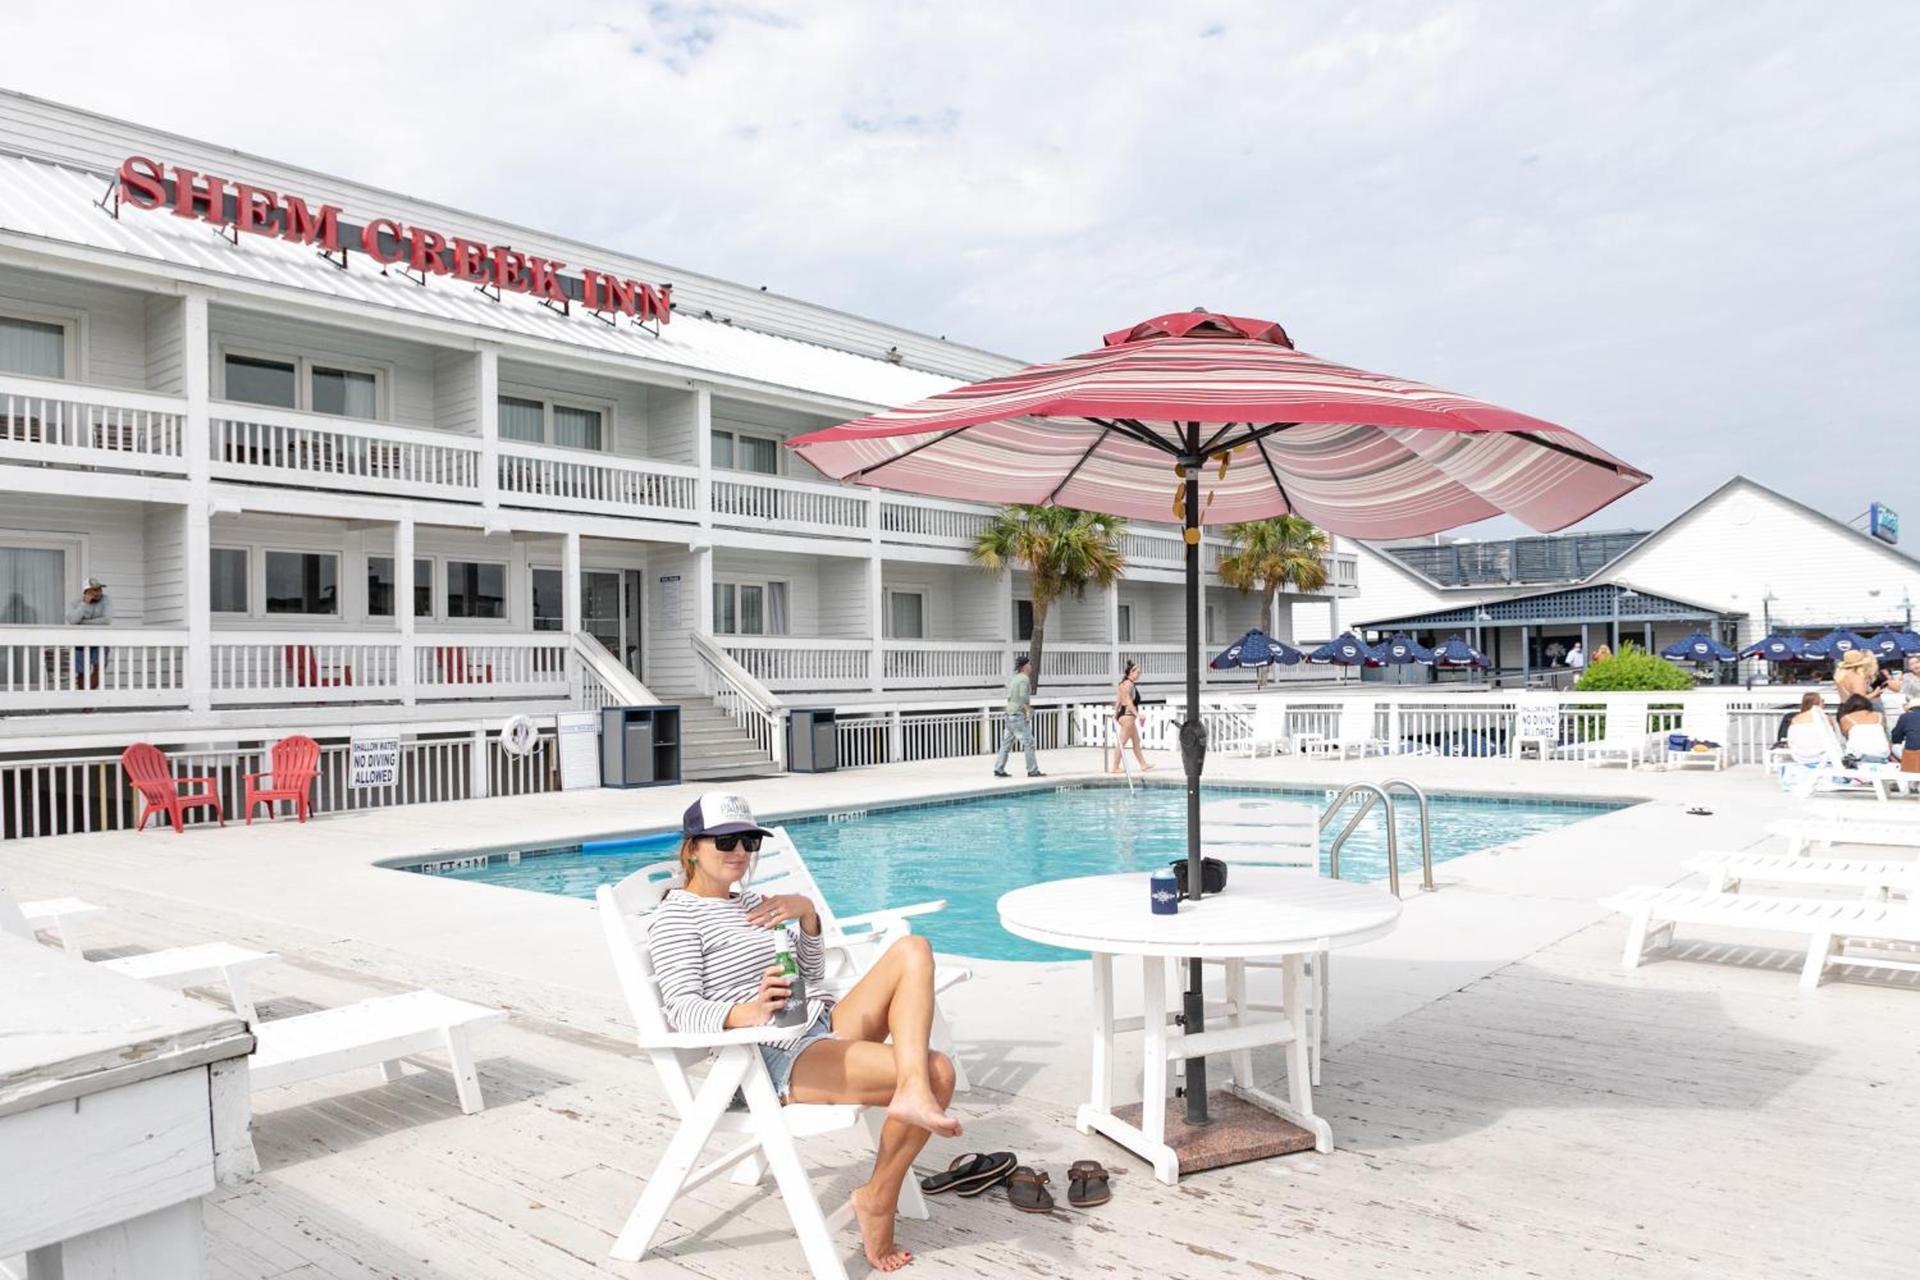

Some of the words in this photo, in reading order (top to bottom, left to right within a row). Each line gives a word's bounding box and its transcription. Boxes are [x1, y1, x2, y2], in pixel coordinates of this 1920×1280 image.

[119, 155, 343, 252] SHEM
[361, 218, 568, 303] CREEK
[581, 268, 673, 325] INN
[354, 755, 366, 768] NO
[368, 753, 396, 768] DIVING
[355, 769, 393, 784] ALLOWED
